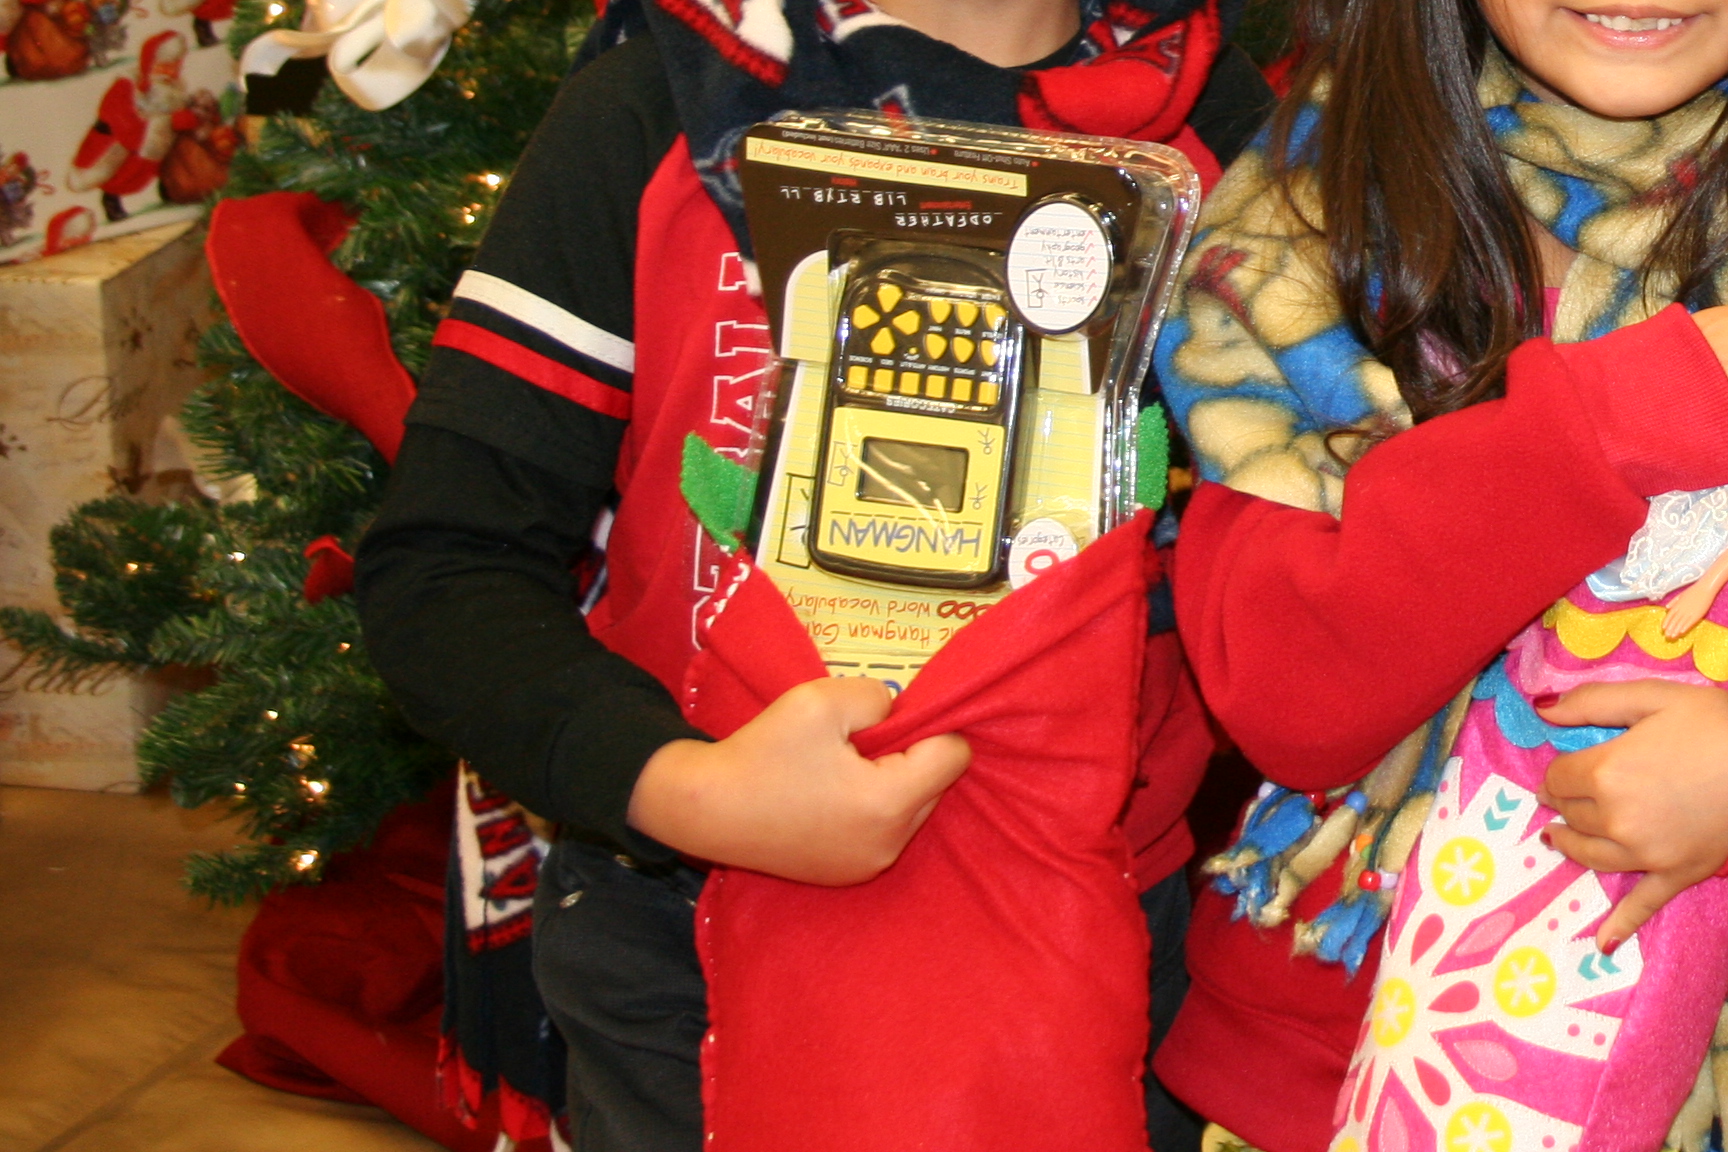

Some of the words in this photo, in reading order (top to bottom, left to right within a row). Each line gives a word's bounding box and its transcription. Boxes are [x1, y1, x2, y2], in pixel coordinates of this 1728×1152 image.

[754, 141, 817, 162] vocabulary!
[820, 152, 845, 166] your
[849, 157, 894, 173] expands
[895, 165, 917, 177] and
[920, 167, 949, 182] brain
[953, 169, 978, 183] your
[983, 174, 1019, 190] Trains
[829, 519, 982, 558] HANGMAN
[786, 586, 880, 618] Vocabulary
[887, 600, 931, 618] Word
[848, 620, 930, 650] Hangman
